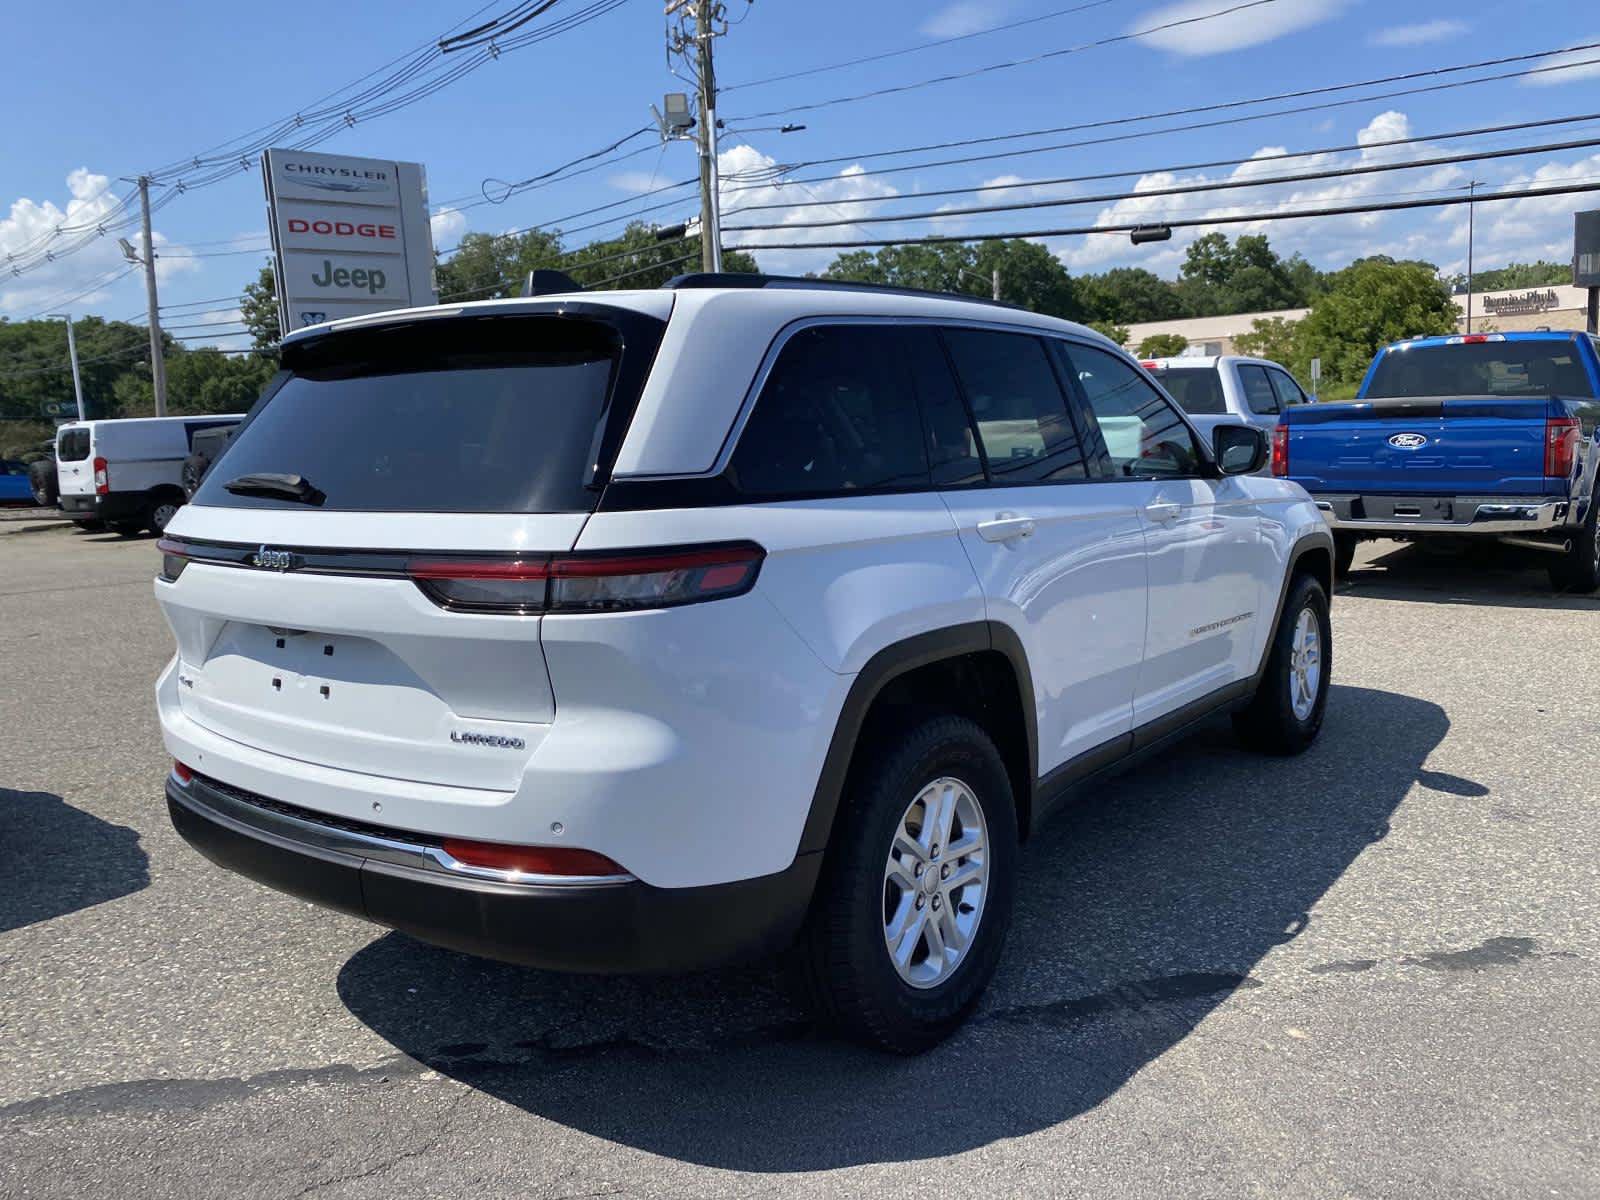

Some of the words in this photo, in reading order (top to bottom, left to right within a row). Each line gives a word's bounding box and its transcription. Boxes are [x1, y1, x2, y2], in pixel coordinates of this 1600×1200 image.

[285, 163, 387, 181] CHRYSLER
[288, 219, 397, 239] DODGE
[312, 260, 386, 294] Jeep
[252, 544, 289, 573] Jeep
[450, 731, 525, 750] LAREDO
